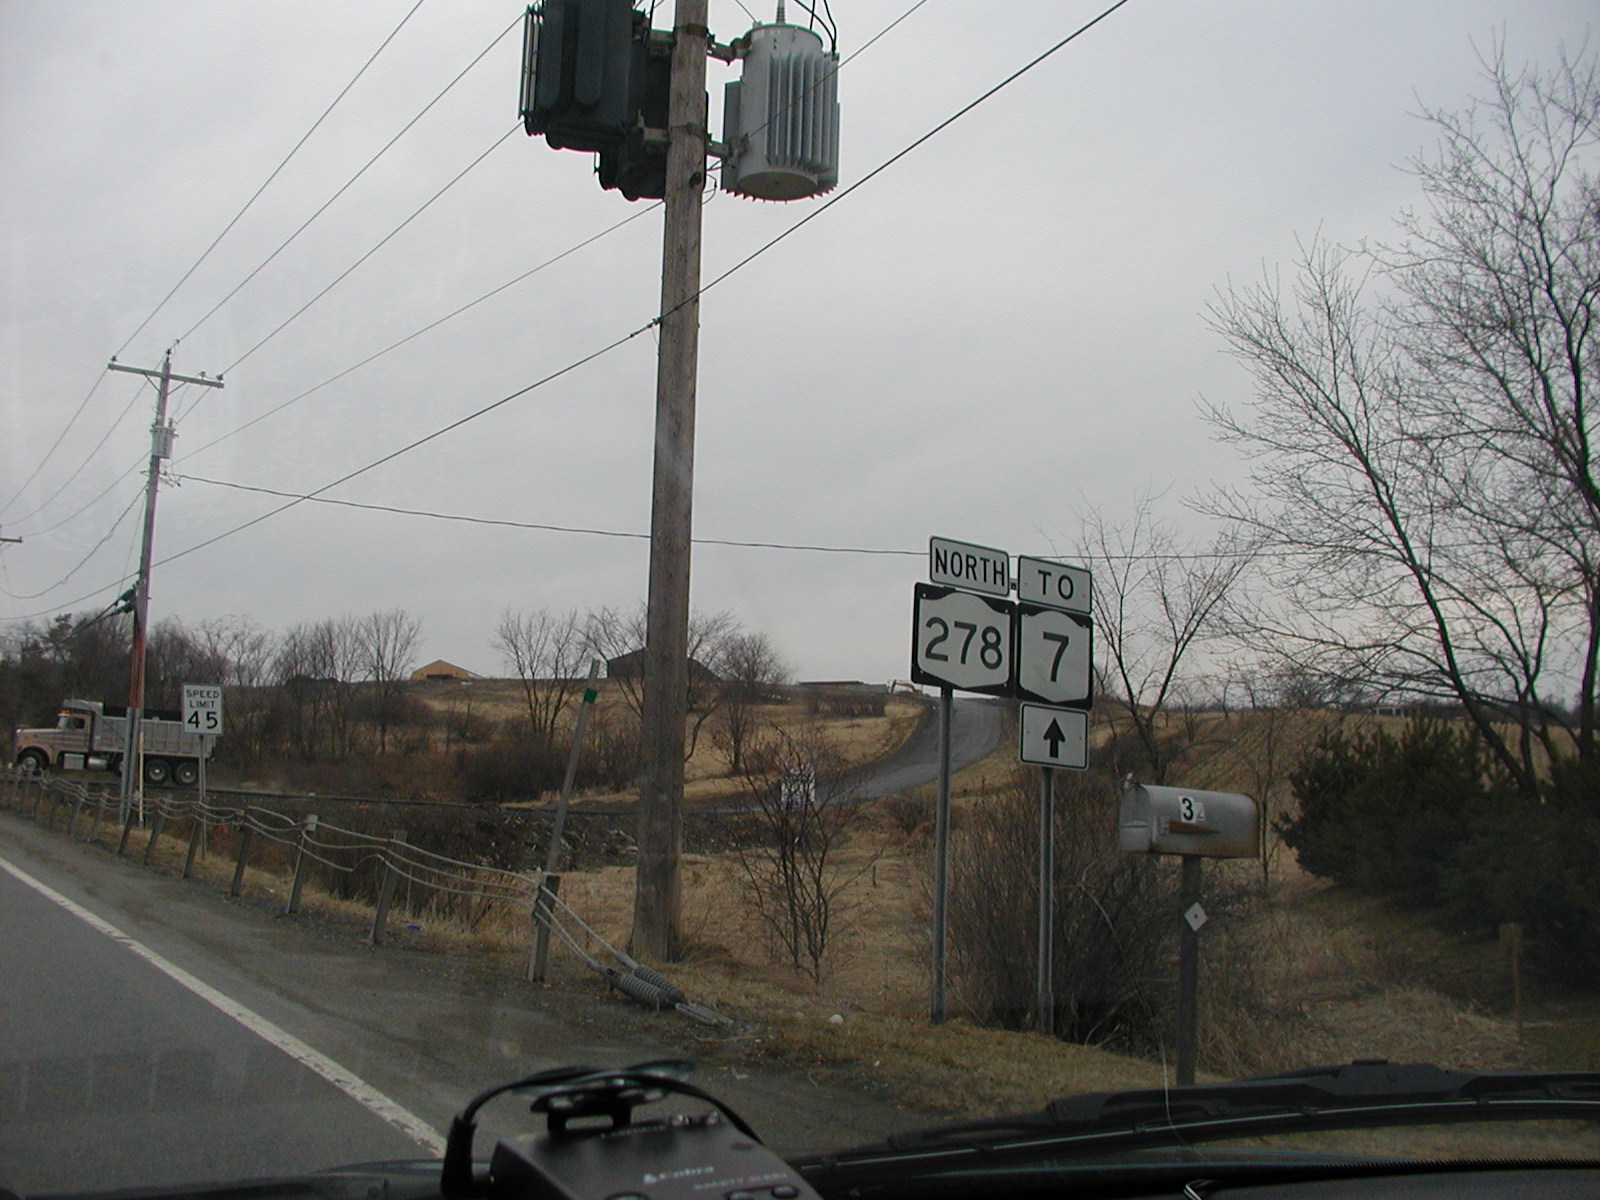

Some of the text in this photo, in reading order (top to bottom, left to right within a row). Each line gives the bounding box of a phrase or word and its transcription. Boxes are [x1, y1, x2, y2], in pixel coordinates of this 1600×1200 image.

[935, 548, 1005, 587] NORTH
[1038, 570, 1074, 600] TO
[925, 617, 1003, 670] 278
[1043, 632, 1069, 682] 7
[186, 689, 219, 698] SPEED
[189, 699, 216, 708] LIMIT
[187, 710, 218, 729] 45
